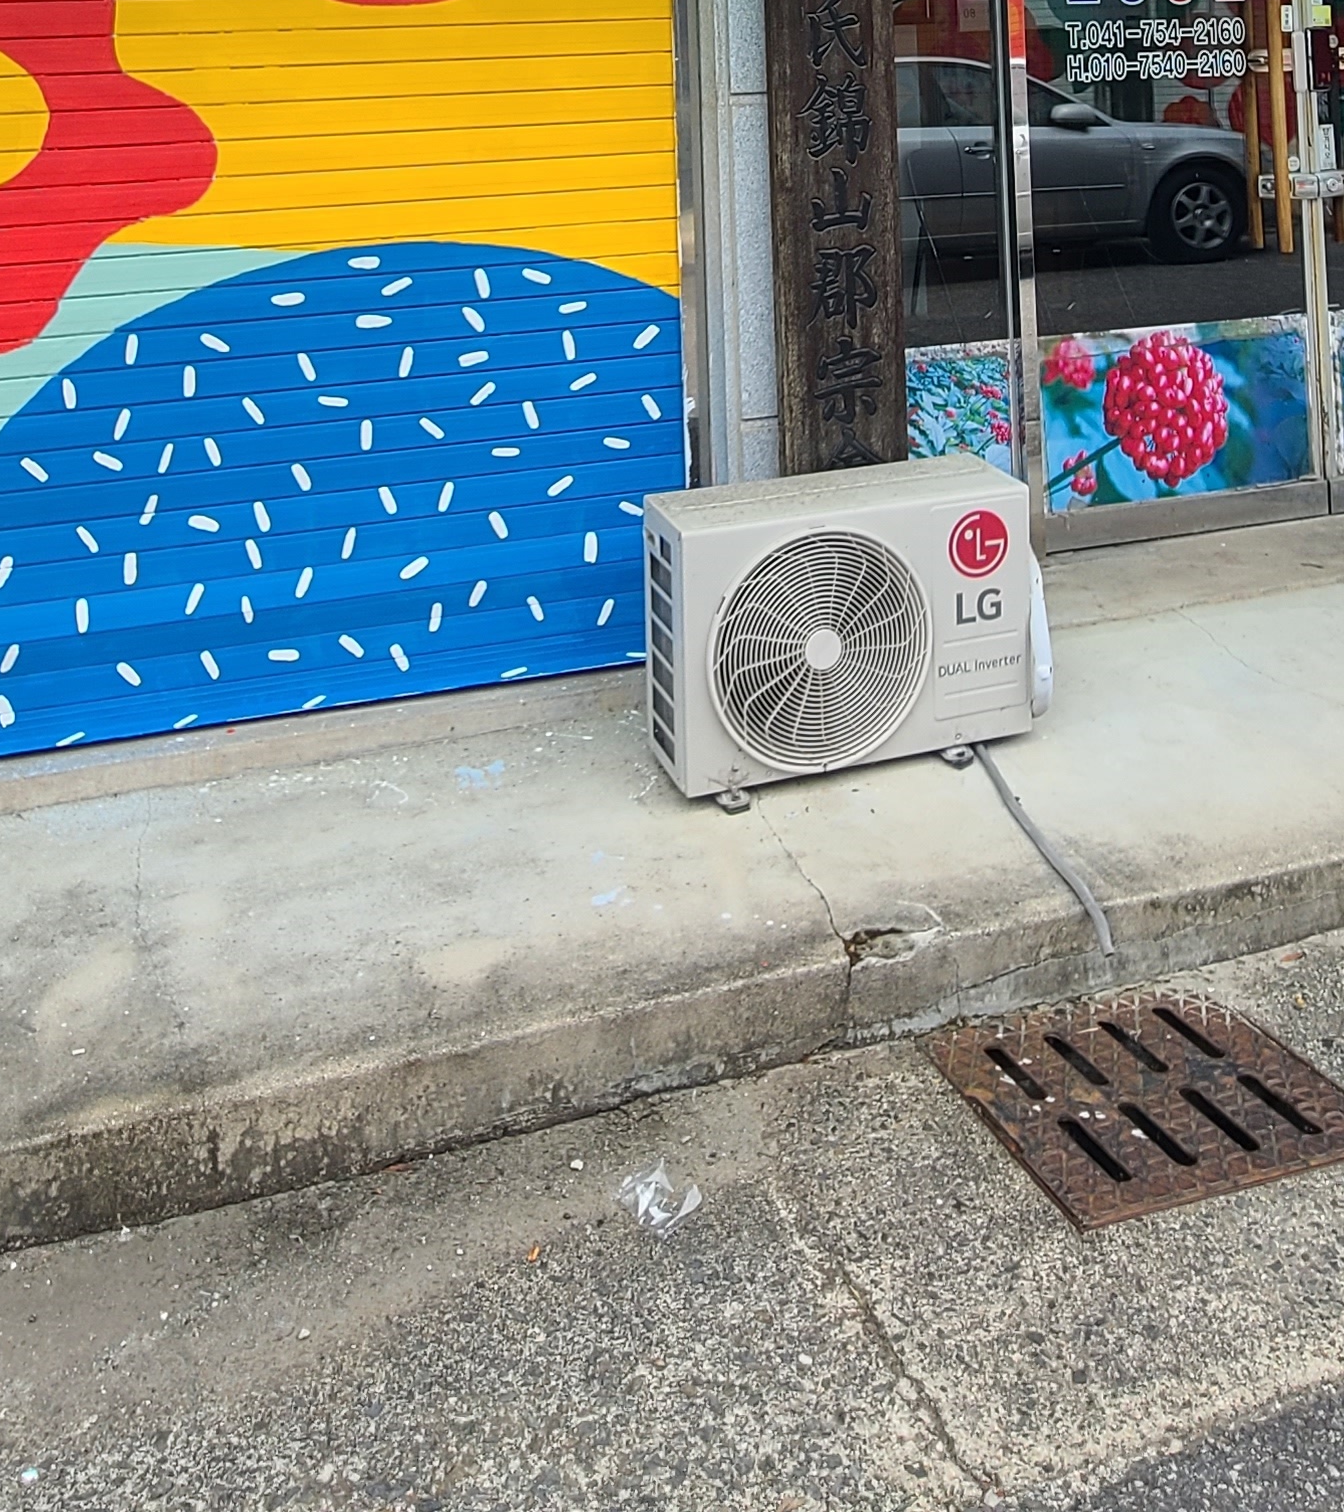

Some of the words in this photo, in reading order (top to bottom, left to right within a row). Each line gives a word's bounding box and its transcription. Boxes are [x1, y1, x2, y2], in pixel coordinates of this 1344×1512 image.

[1065, 16, 1245, 50] T.041-754-2160
[1067, 49, 1247, 83] H.010-7540-2160
[956, 588, 1003, 626] LG
[938, 660, 971, 678] DUAL
[975, 654, 1022, 672] Inverter
